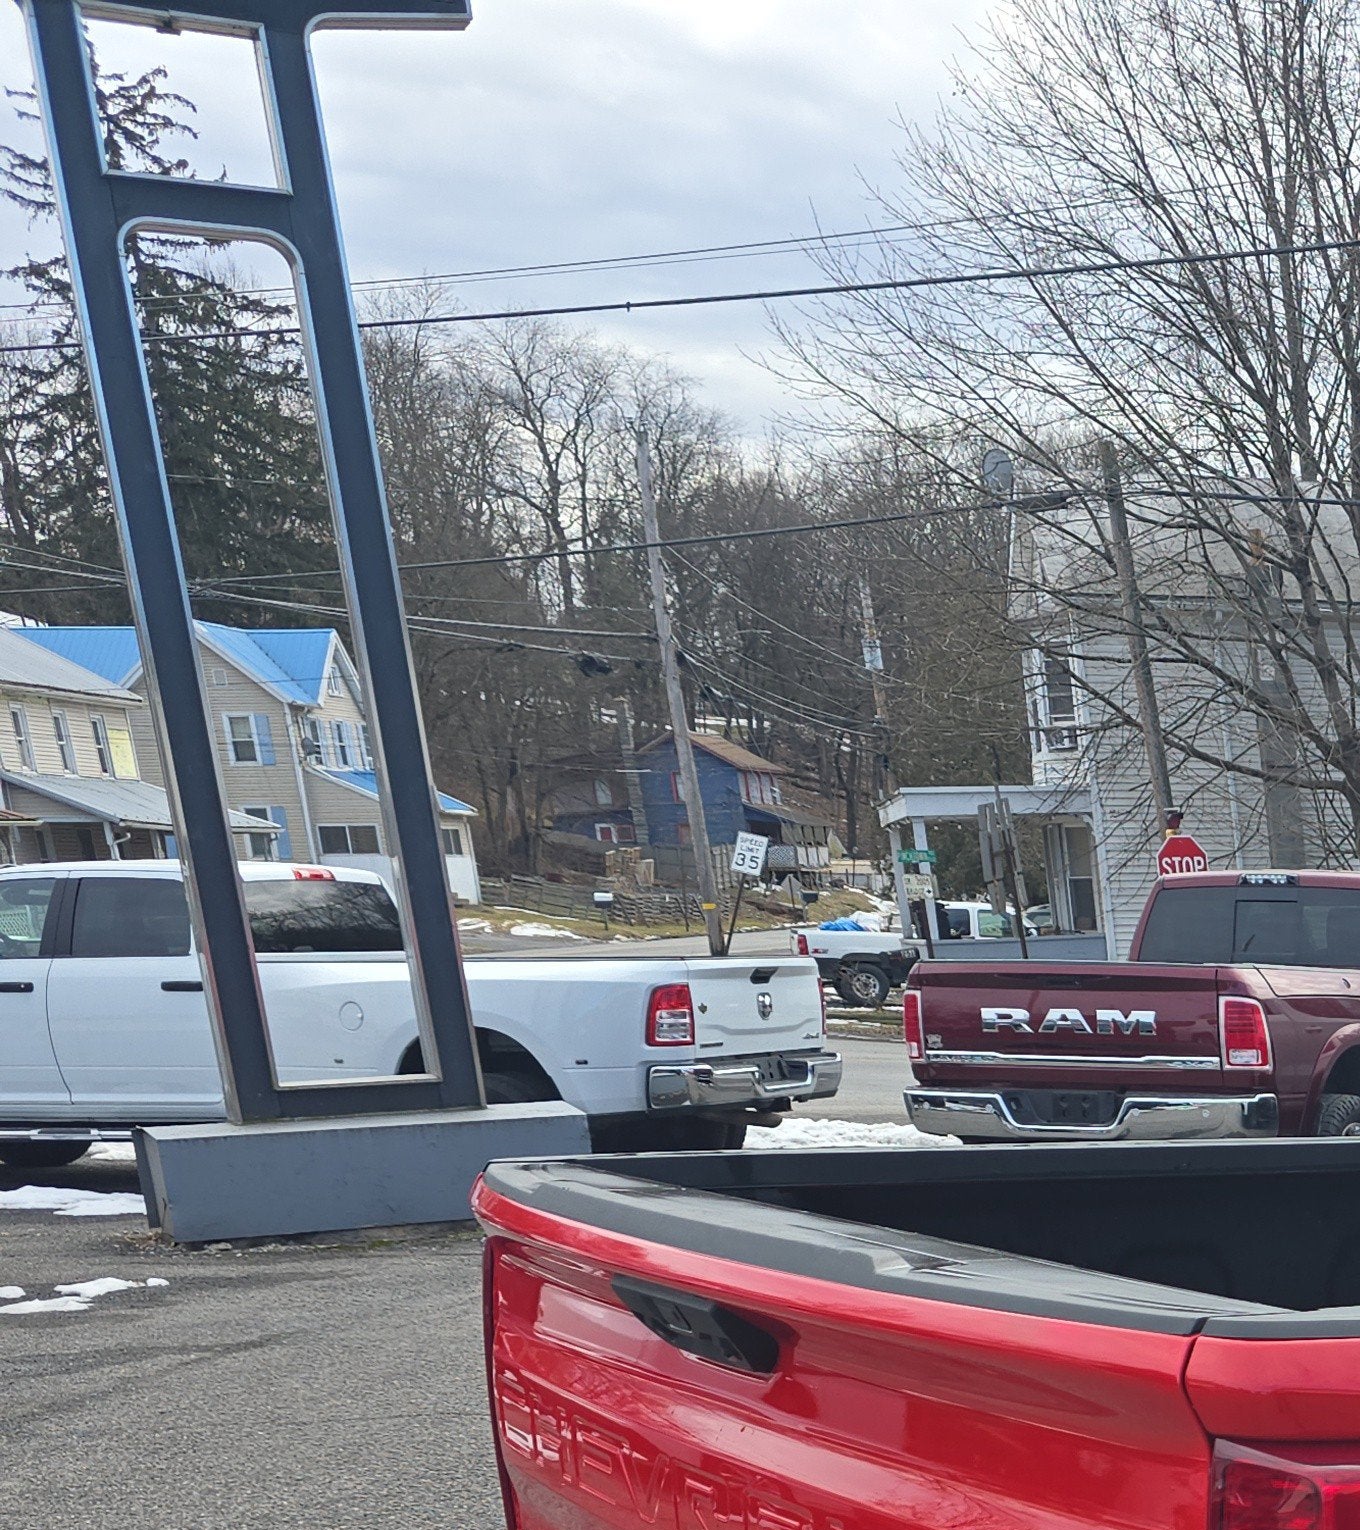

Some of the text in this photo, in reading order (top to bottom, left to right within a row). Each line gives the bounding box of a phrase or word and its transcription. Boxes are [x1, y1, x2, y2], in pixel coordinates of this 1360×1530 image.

[734, 852, 760, 870] 35
[1161, 856, 1205, 874] STOP
[980, 1007, 1157, 1036] RAM
